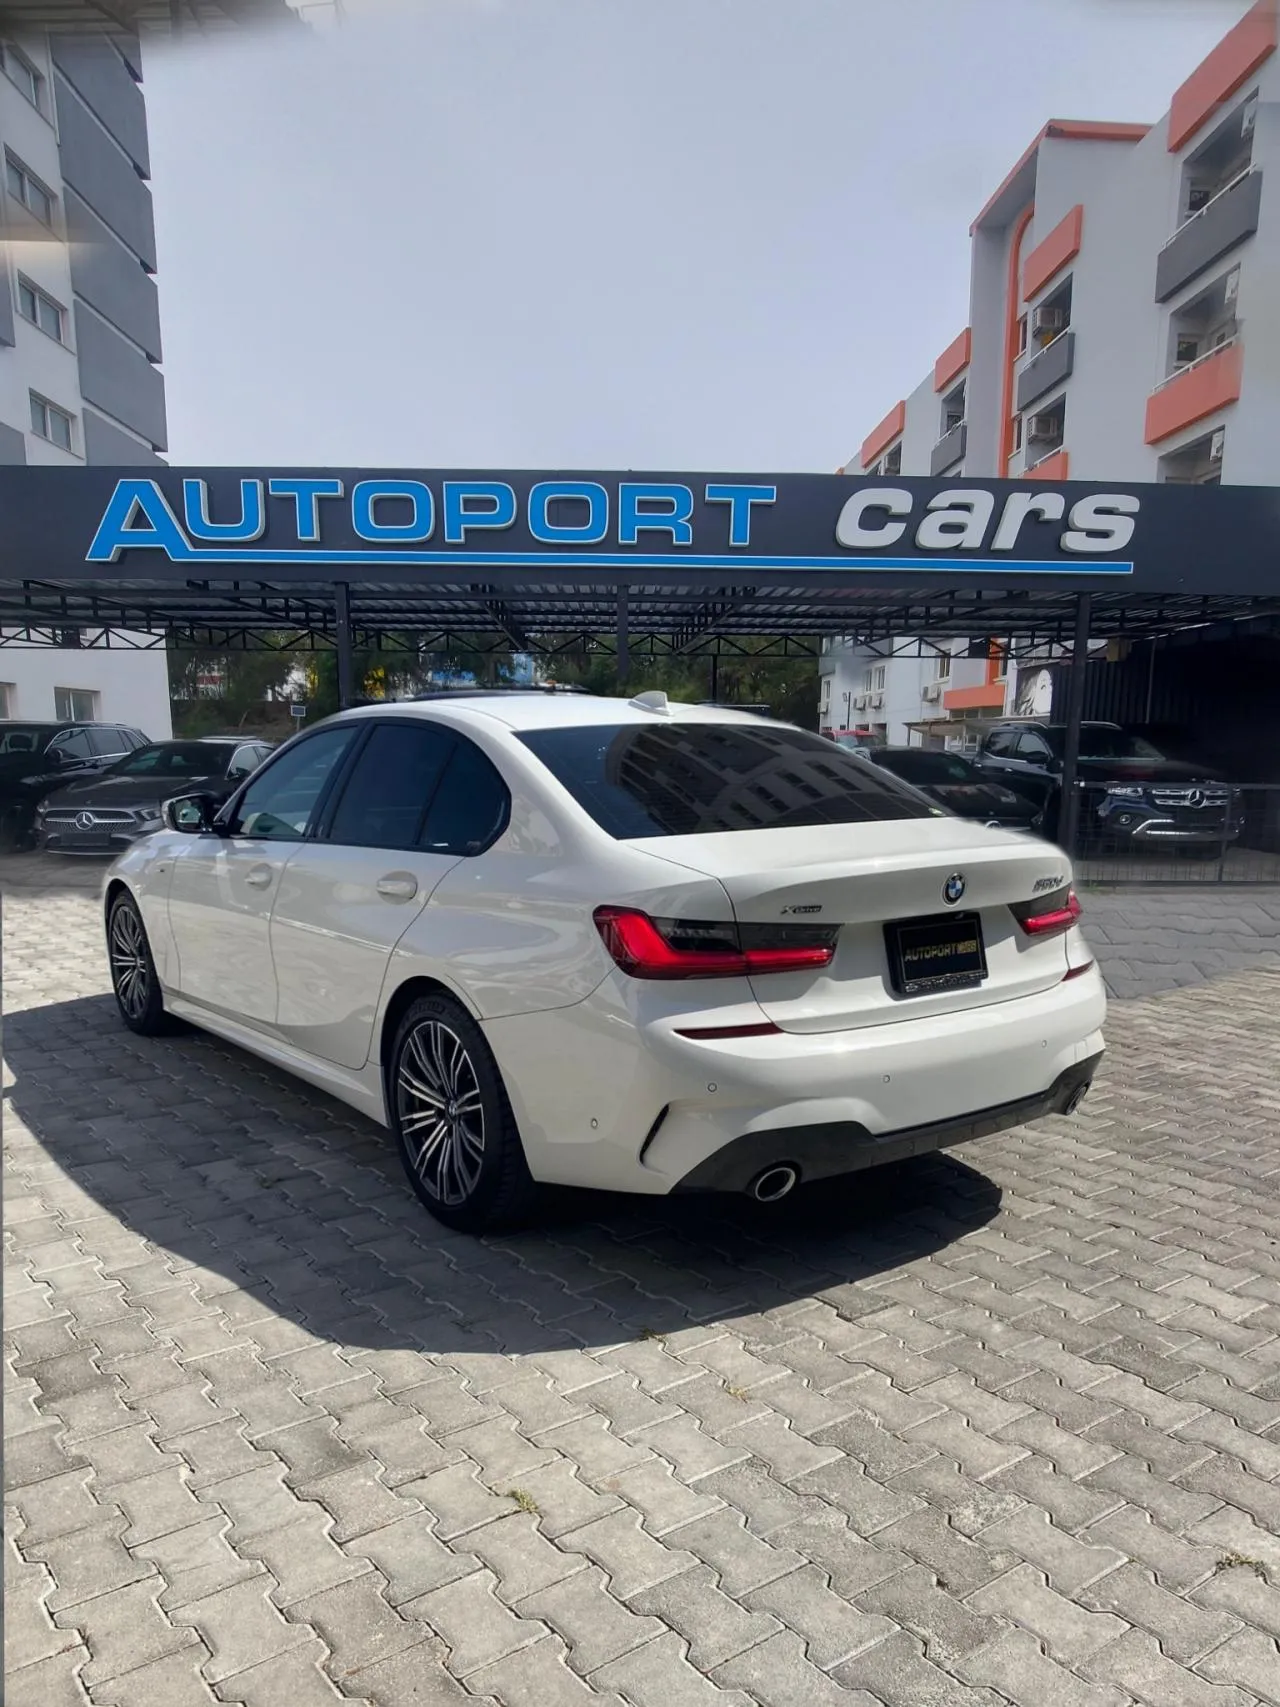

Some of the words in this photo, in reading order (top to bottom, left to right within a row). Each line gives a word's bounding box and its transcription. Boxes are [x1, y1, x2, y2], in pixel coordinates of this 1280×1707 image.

[85, 477, 779, 563] AUTOPORT
[836, 487, 1141, 553] cars
[904, 943, 958, 961] AUTOPORT
